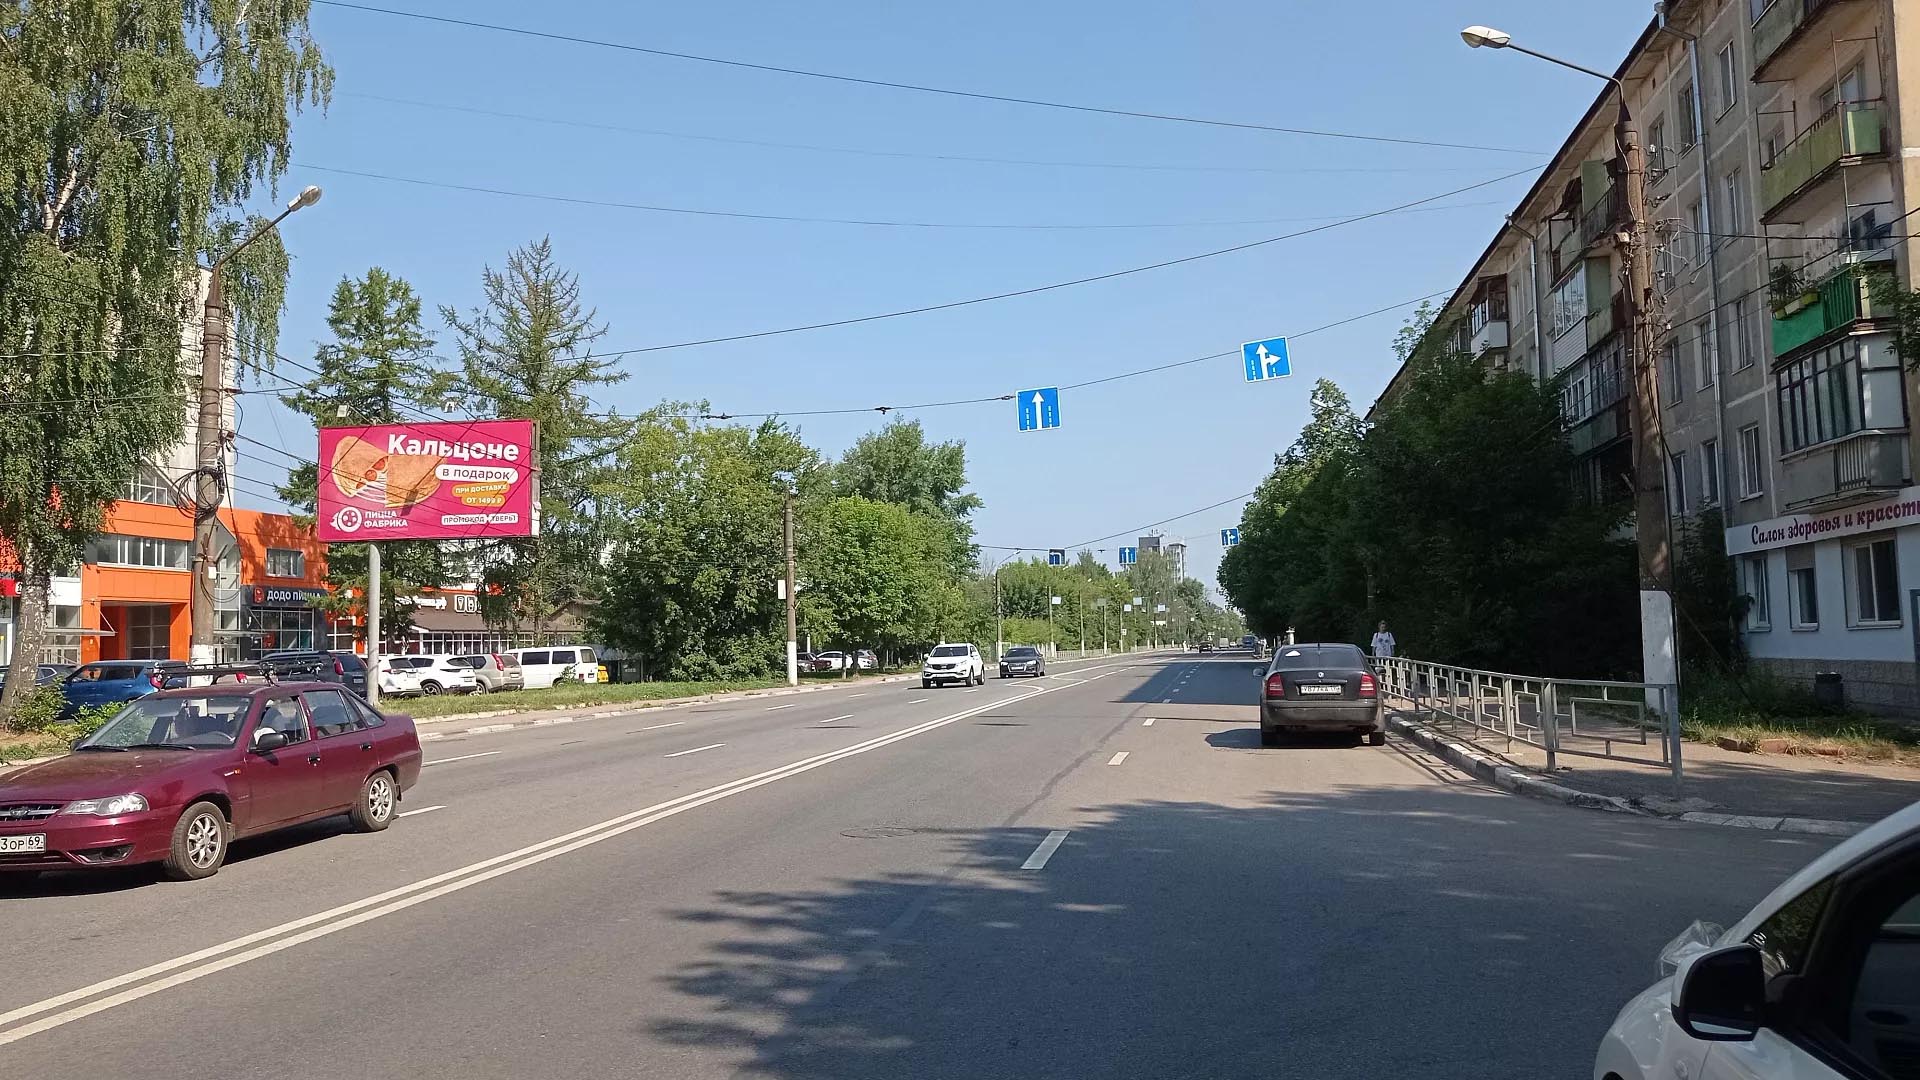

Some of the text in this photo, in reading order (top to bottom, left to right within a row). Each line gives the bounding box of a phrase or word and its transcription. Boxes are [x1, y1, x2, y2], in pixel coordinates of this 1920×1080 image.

[388, 433, 519, 462] Кальцоне
[442, 468, 510, 480] в подарок
[470, 484, 507, 493] ДОСТАВКЕ
[365, 510, 397, 519] ПИЦЦА
[364, 519, 408, 528] ФАБРИКА
[1751, 525, 1785, 545] Салон
[1788, 516, 1841, 540] здоровья
[1844, 513, 1853, 526] и
[267, 590, 292, 601] ДОДО
[28, 836, 41, 846] 69
